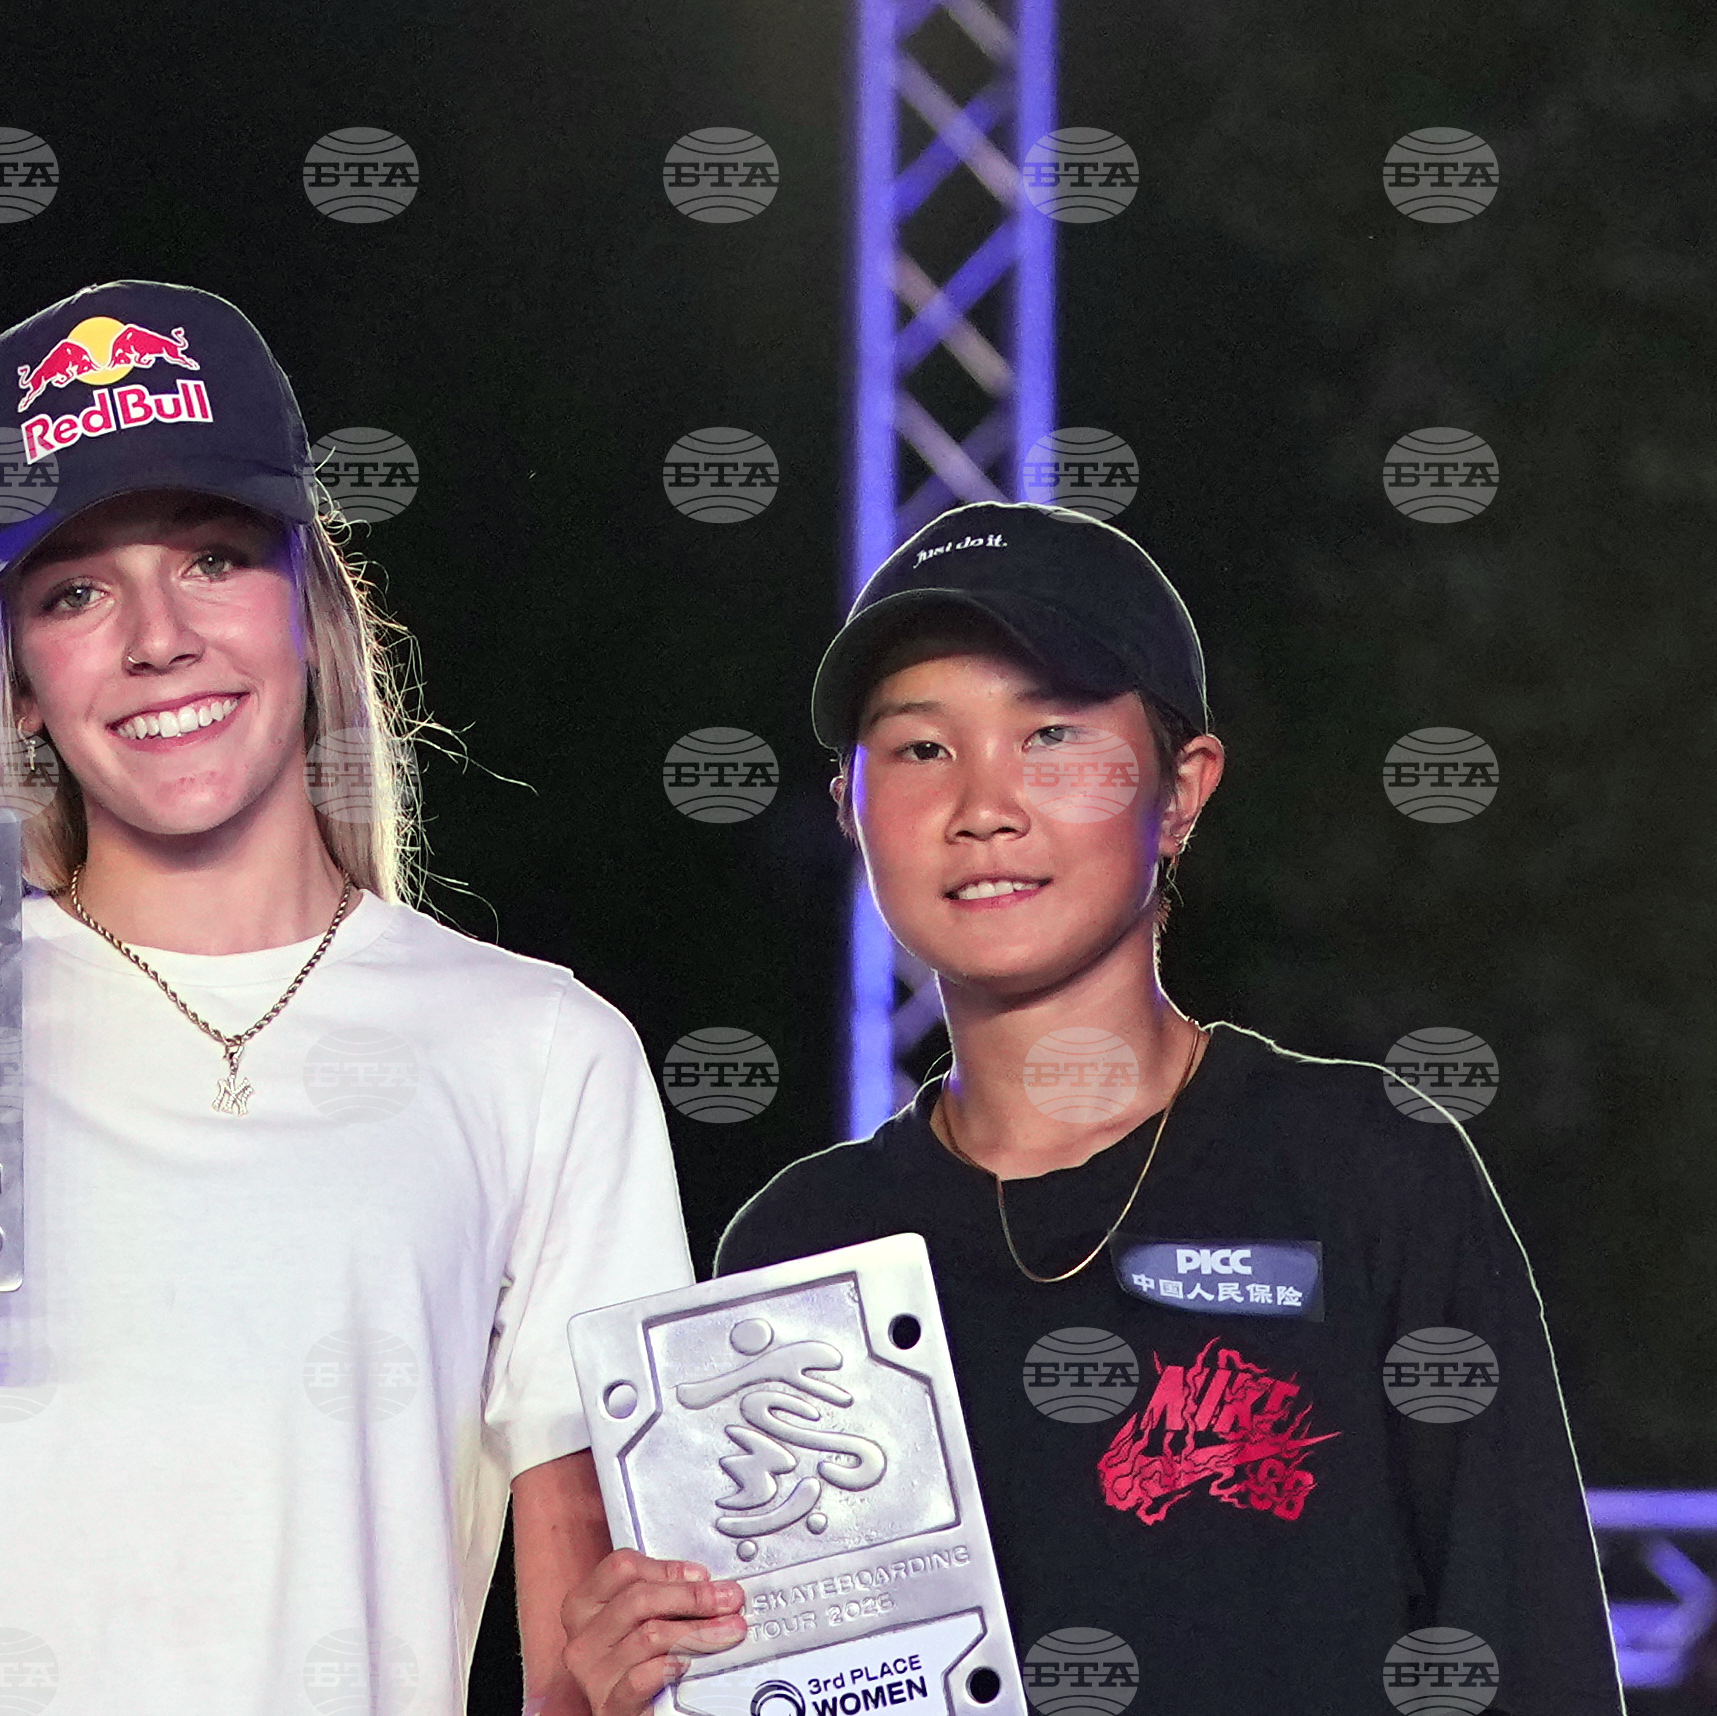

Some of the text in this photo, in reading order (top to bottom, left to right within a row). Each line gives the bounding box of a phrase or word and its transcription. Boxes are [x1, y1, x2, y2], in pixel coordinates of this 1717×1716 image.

[20, 379, 214, 465] Red Bull
[955, 536, 984, 550] do
[1176, 1249, 1252, 1275] PICC
[1132, 1273, 1303, 1307] 中国人民保险
[752, 1545, 971, 1615] SKATEBOARDING
[748, 1611, 818, 1642] TOUR
[807, 1653, 923, 1697] 3rd PLACE
